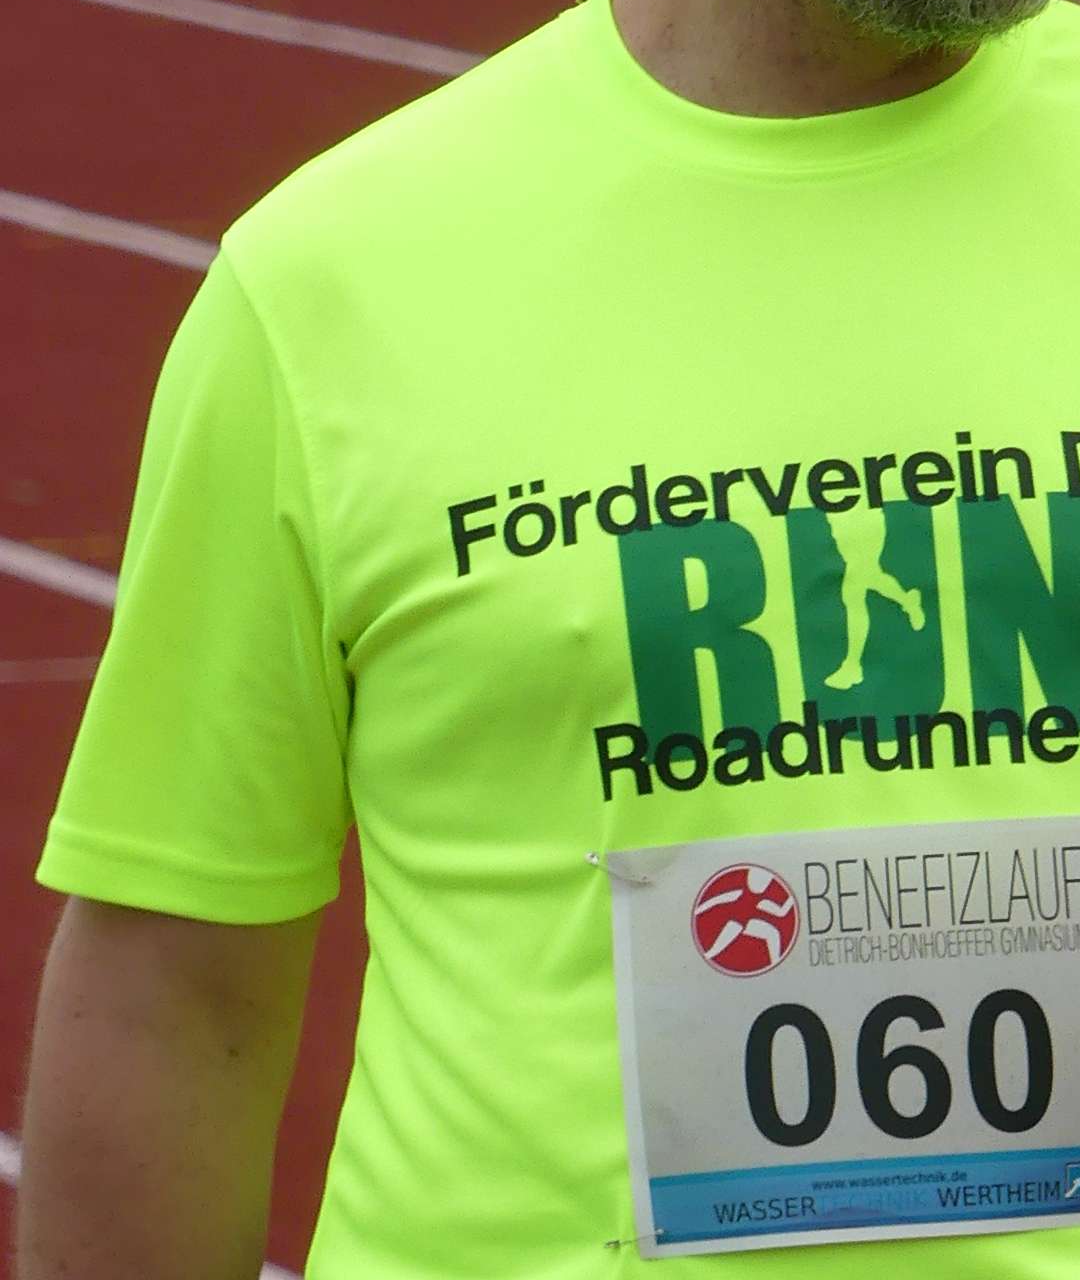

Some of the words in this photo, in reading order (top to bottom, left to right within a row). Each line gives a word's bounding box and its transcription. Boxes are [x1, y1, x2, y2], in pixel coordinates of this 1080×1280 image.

[447, 432, 1034, 575] Förderverein
[809, 929, 996, 967] DIETRICH-BONHOEFFER
[745, 988, 1053, 1147] 060
[811, 1170, 968, 1191] www.wassertechnik.de
[937, 1181, 1061, 1208] WERTHEIM
